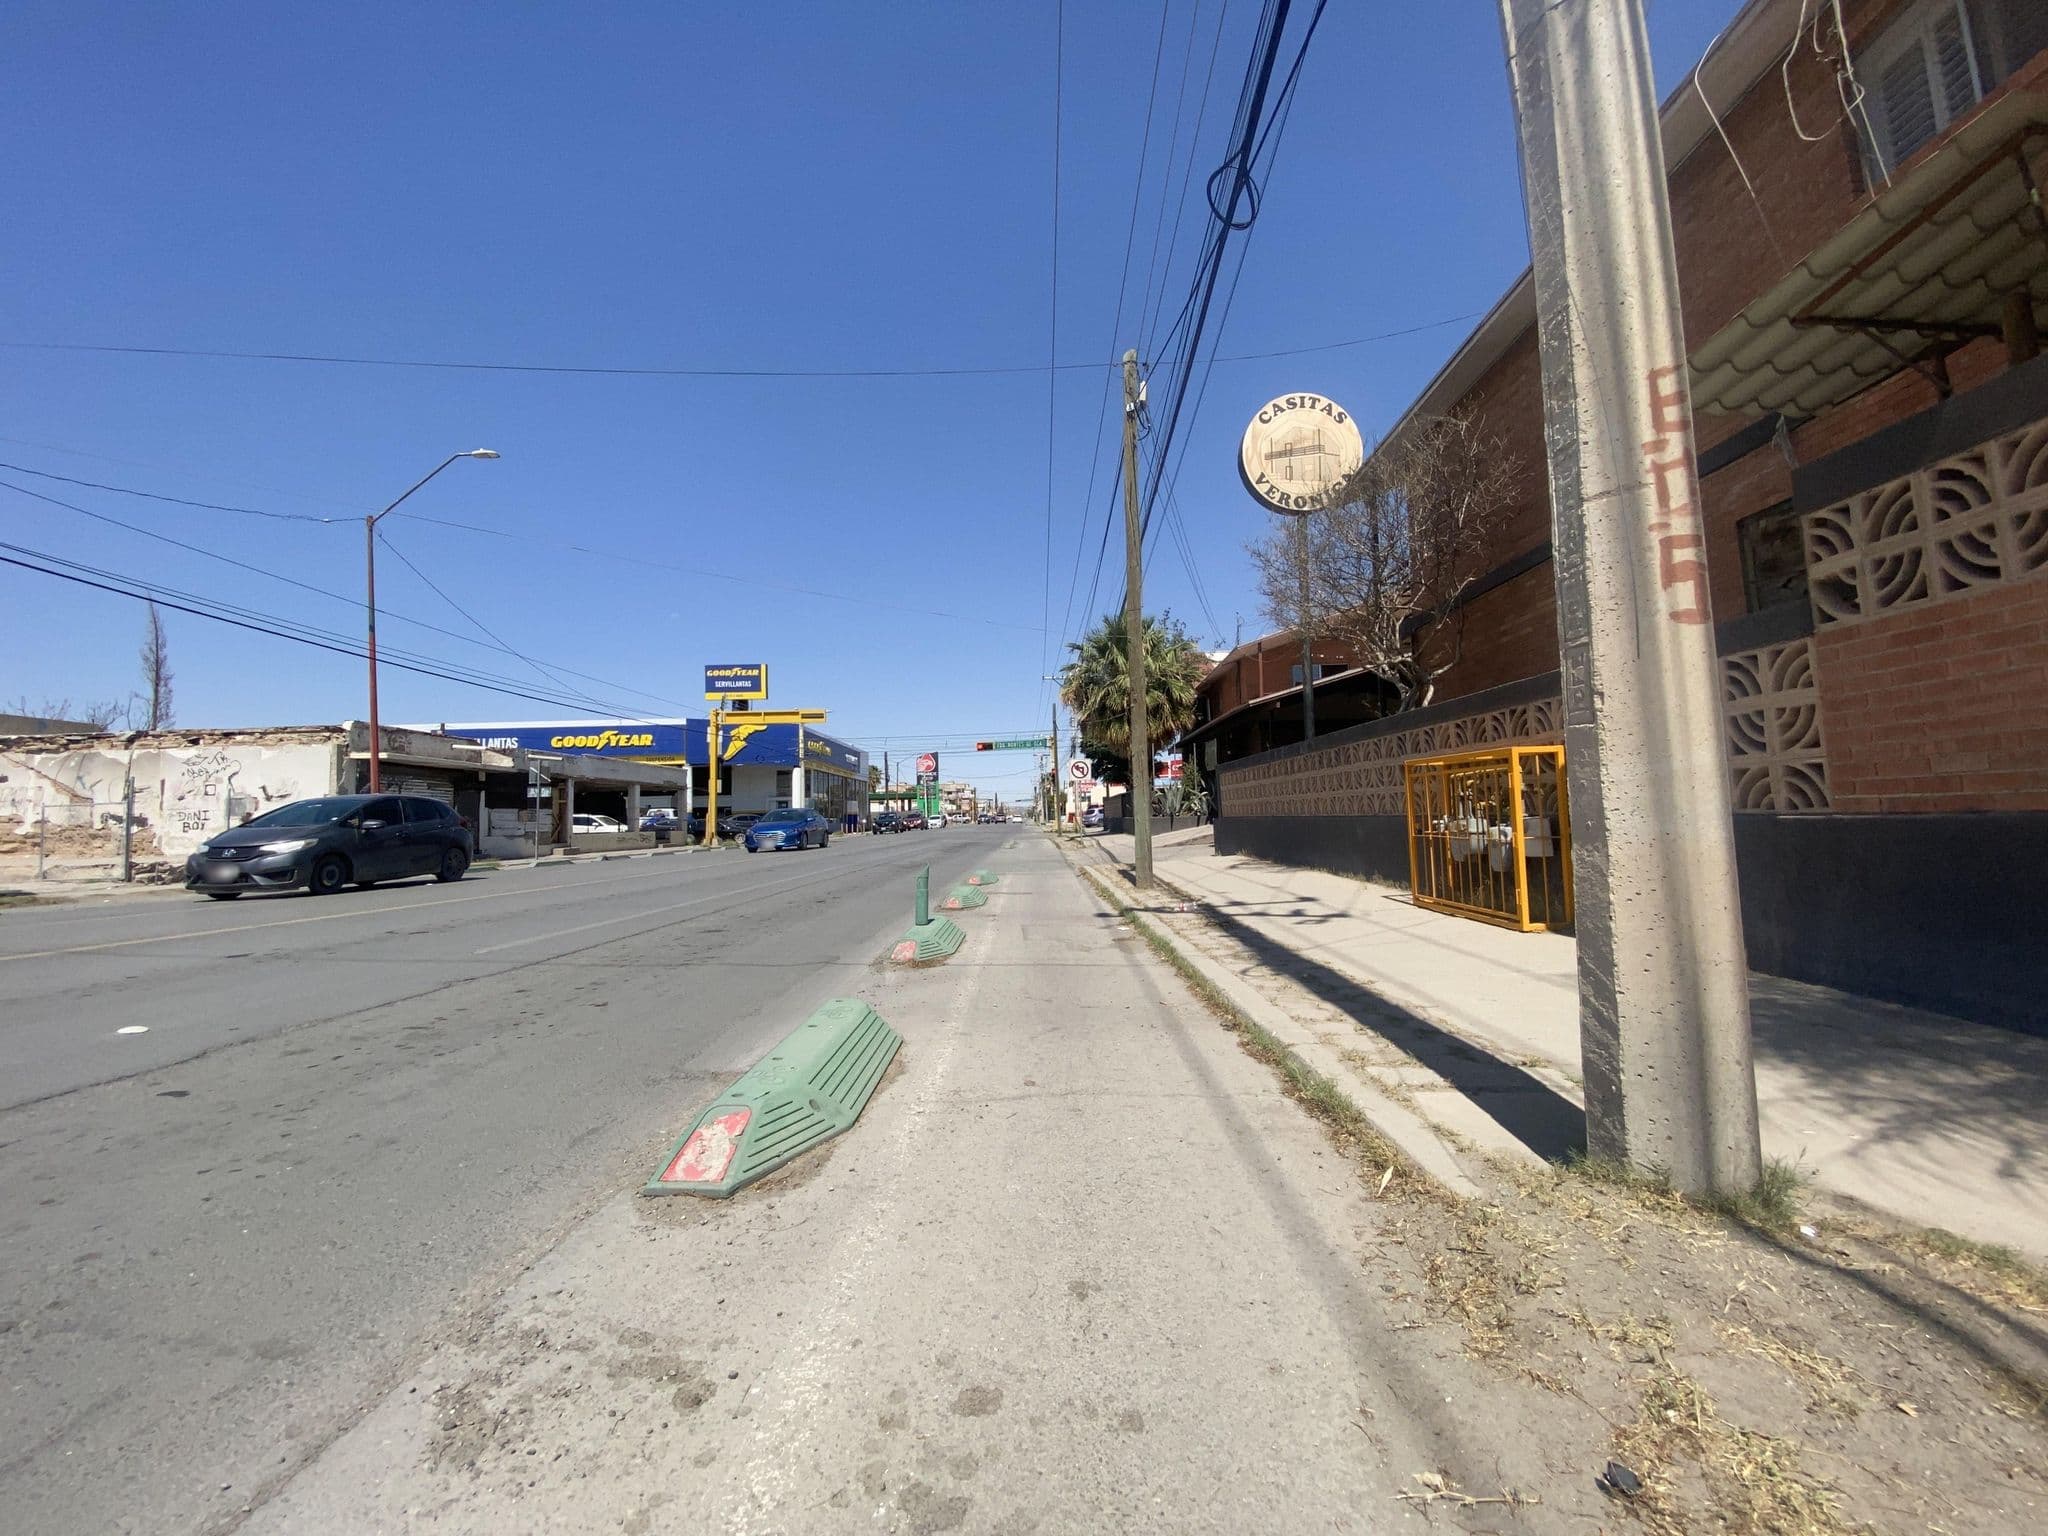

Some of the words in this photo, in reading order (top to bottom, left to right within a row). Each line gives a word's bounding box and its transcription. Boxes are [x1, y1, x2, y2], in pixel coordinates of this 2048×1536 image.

[1258, 395, 1348, 425] CASITAS
[707, 667, 760, 678] GOODYEAR
[714, 680, 752, 689] SERVILLANTAS
[550, 732, 654, 749] GOODYEAR
[177, 809, 211, 822] DANI
[182, 821, 206, 833] BOY
